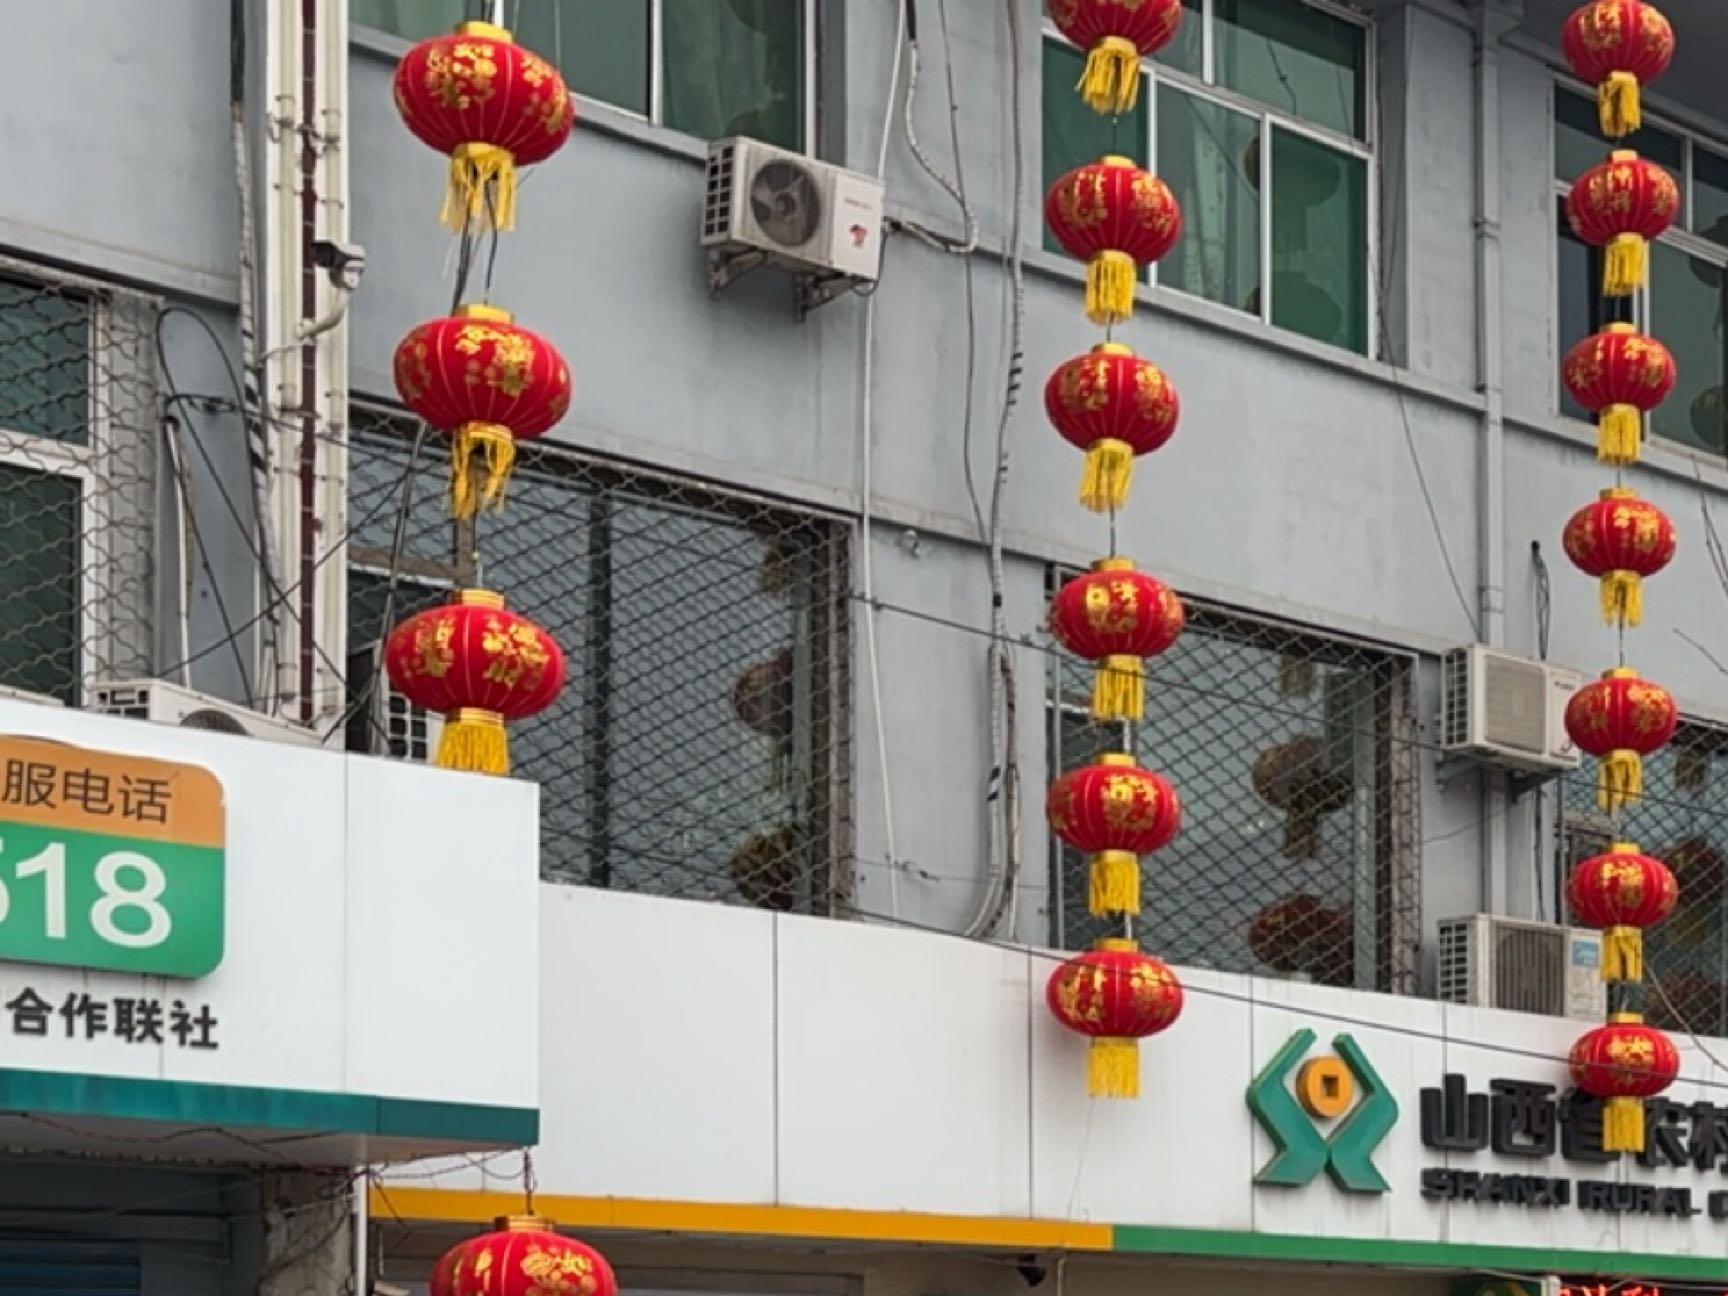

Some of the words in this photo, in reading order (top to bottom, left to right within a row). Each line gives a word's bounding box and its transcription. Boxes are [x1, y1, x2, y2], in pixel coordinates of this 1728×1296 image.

[2, 758, 173, 825] 服电话
[0, 838, 173, 949] 18
[5, 986, 220, 1051] 合作联社
[1419, 1167, 1571, 1208] SHANXI
[1576, 1180, 1702, 1217] RURAL
